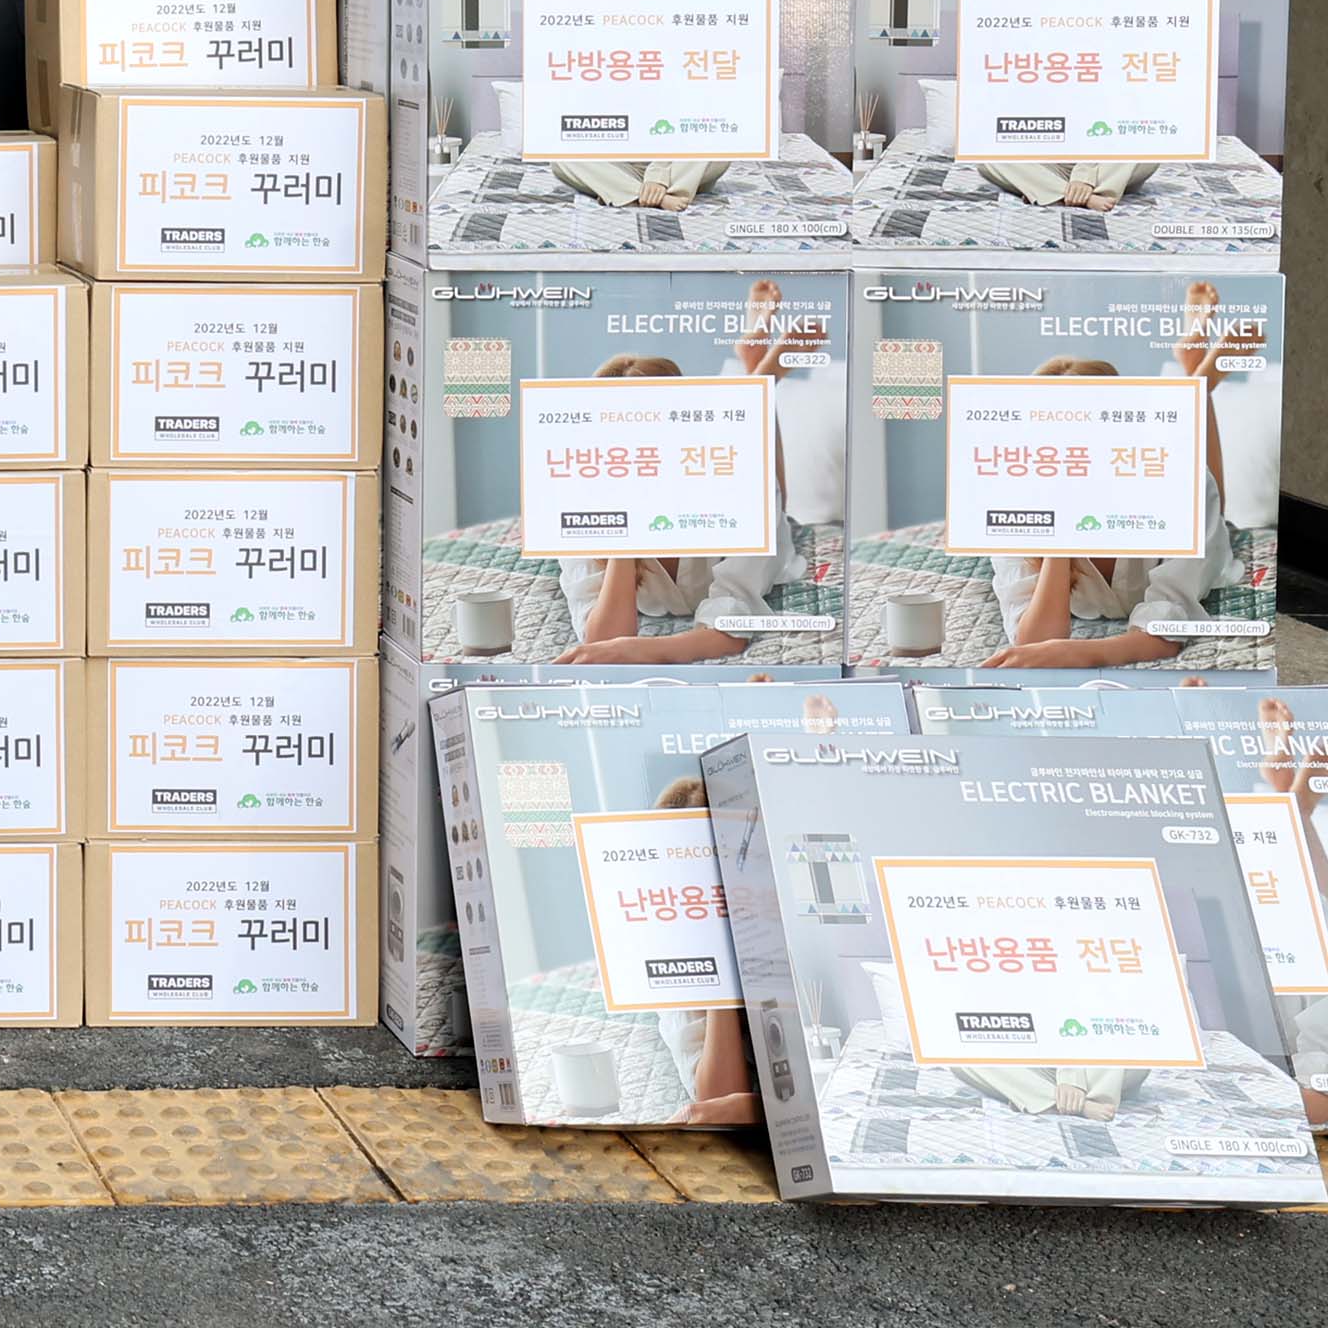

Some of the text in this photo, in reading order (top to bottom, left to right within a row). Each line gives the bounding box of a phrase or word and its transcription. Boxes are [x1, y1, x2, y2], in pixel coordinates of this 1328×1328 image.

[99, 37, 293, 72] 피코크 꾸러미
[548, 49, 741, 81] 난방용품 전달
[985, 52, 1181, 83] 난방용품 전달
[1152, 223, 1196, 237] DOUBLE
[1200, 223, 1221, 236] 180
[1231, 222, 1274, 239] 135(cm)
[974, 446, 1168, 477] 난방용품 전달
[961, 781, 1208, 807] ELECTRIC BLANKET
[1168, 827, 1214, 842] GK-732
[125, 917, 328, 950] 피코크 꾸러미
[925, 937, 1143, 974] 난방용품 전달
